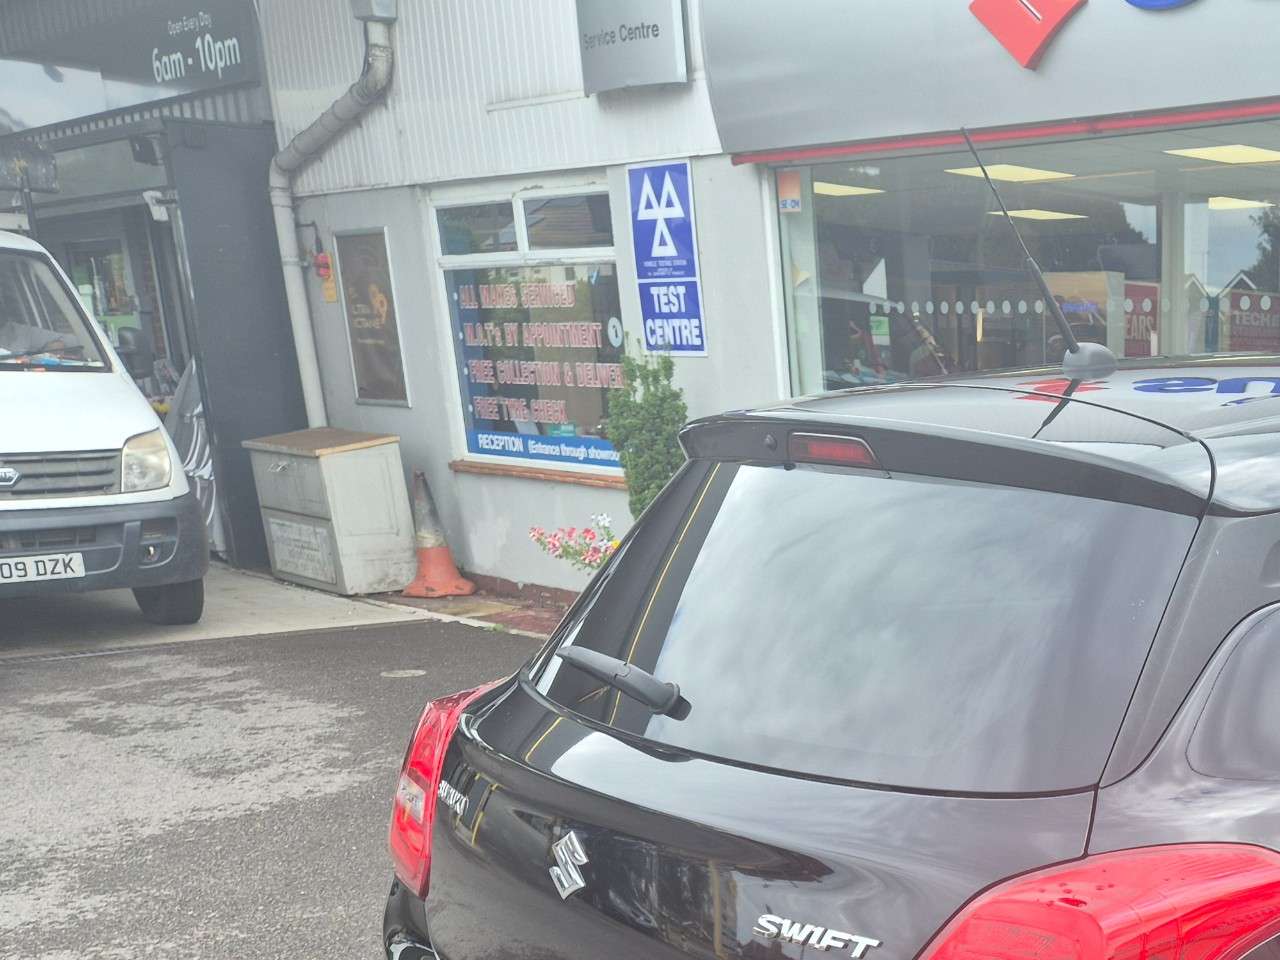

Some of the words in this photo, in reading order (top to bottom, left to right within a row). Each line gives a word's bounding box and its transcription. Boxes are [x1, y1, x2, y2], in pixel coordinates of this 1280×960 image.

[618, 22, 660, 42] Centre
[152, 48, 185, 83] 6am
[195, 33, 241, 80] 10pm
[650, 285, 686, 313] TEST
[503, 322, 519, 347] BY
[522, 321, 602, 348] APPOINTMENT
[645, 318, 702, 345] CENTRE
[468, 359, 496, 384] FREE
[496, 360, 561, 386] COLLECTION
[575, 361, 625, 389] DELIVER
[473, 396, 500, 421] FREE
[477, 433, 524, 453] RECEPTION
[34, 556, 76, 577] DZK
[753, 914, 883, 960] SWIFT
